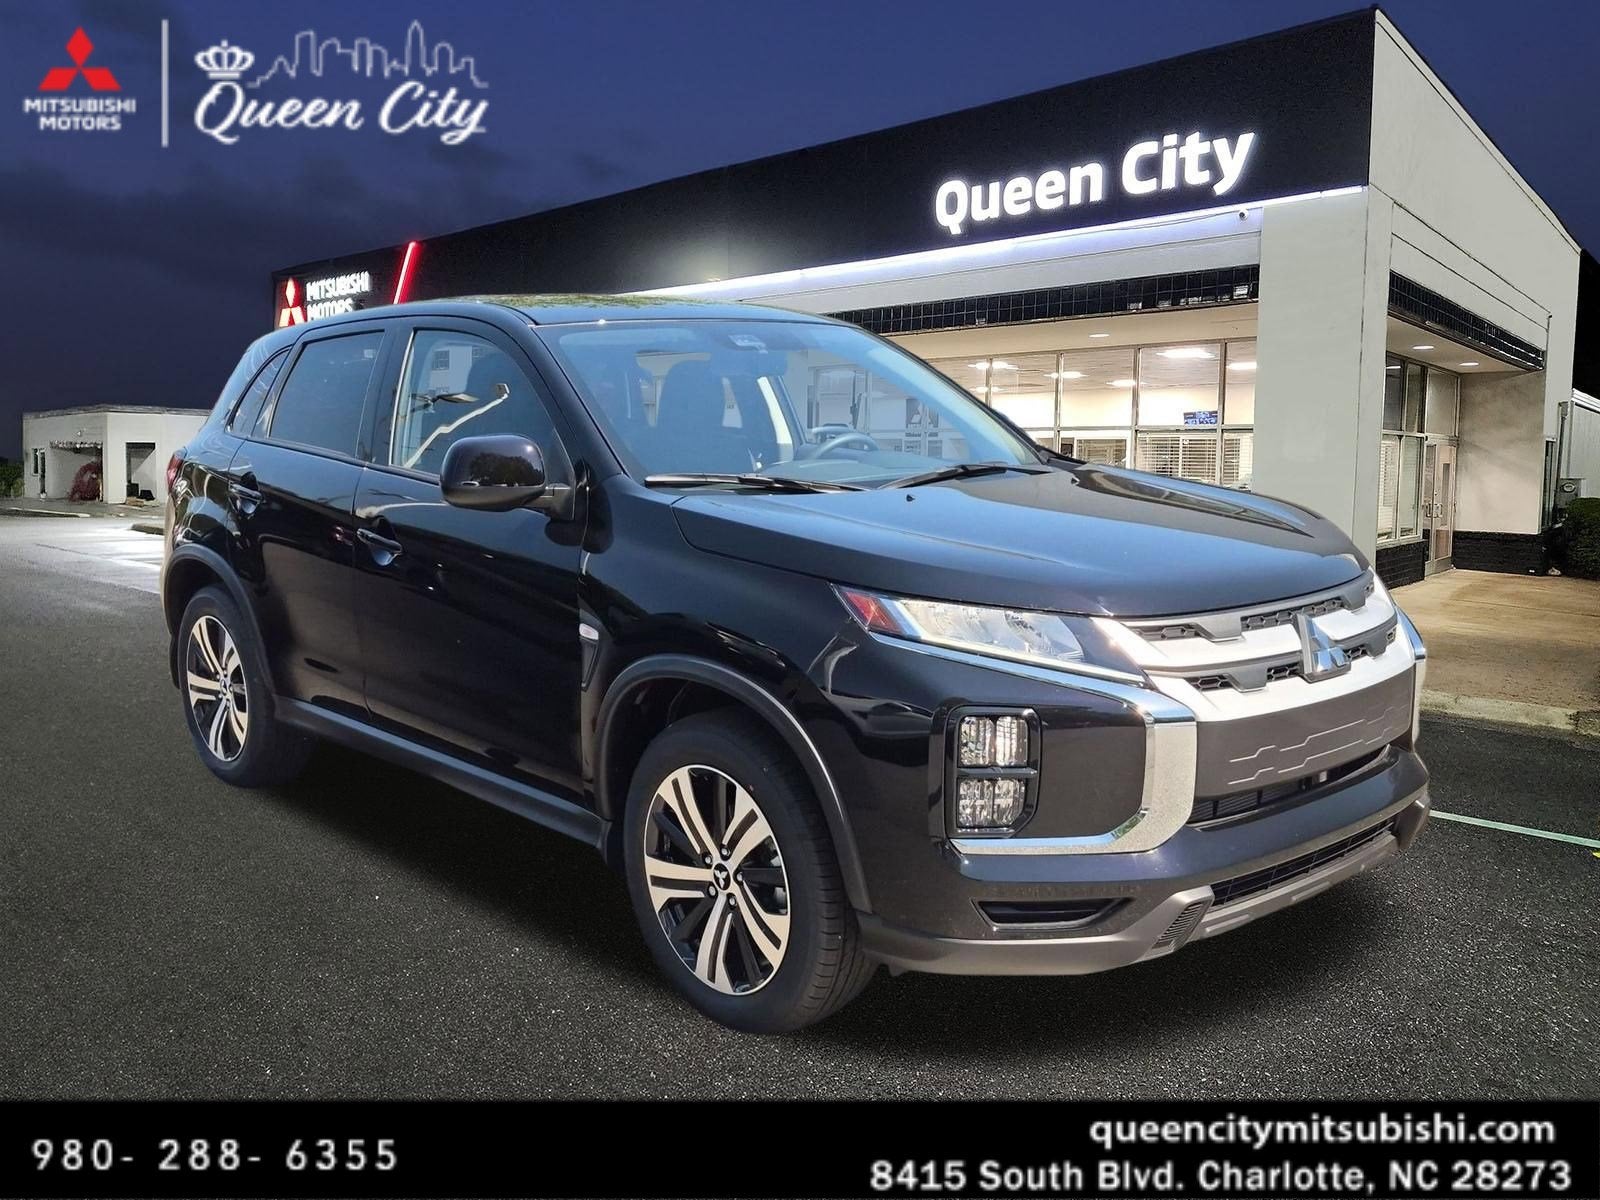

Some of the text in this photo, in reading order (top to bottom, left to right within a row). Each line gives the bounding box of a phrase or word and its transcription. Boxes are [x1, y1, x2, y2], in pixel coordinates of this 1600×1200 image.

[935, 131, 1256, 235] Queen City
[306, 271, 370, 301] MITSUBISHI
